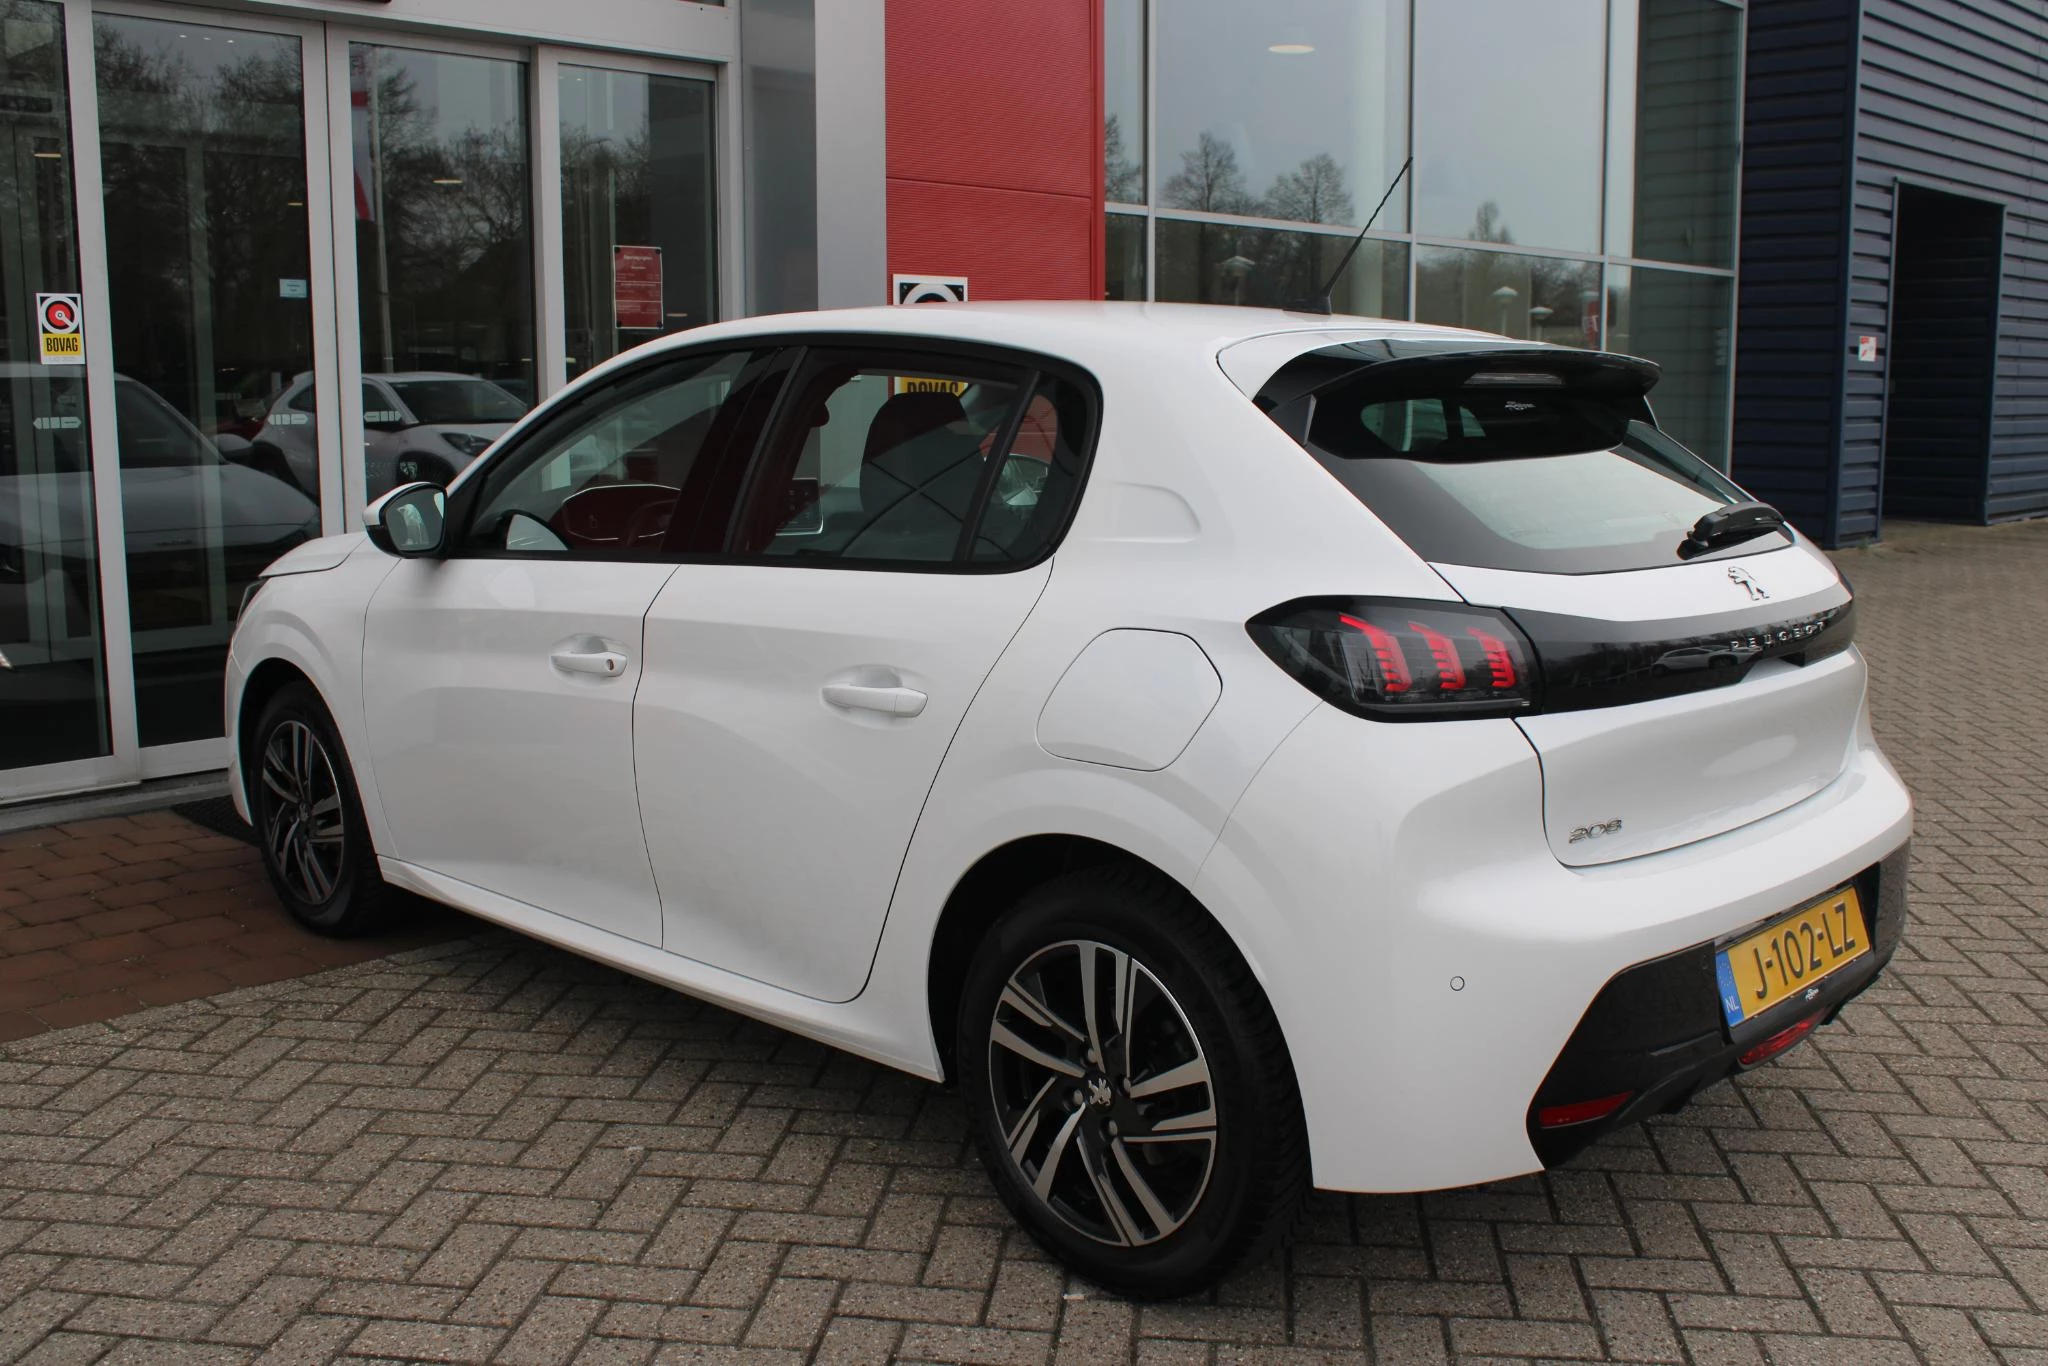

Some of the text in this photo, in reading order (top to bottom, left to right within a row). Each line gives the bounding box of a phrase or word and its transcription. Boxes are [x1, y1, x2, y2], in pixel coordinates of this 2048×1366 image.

[46, 337, 79, 352] BOVAG
[1730, 621, 1824, 649] PEUGEOT
[1568, 819, 1622, 844] 208
[1753, 901, 1856, 1000] J-102-LZ
[1725, 995, 1740, 1014] NL
